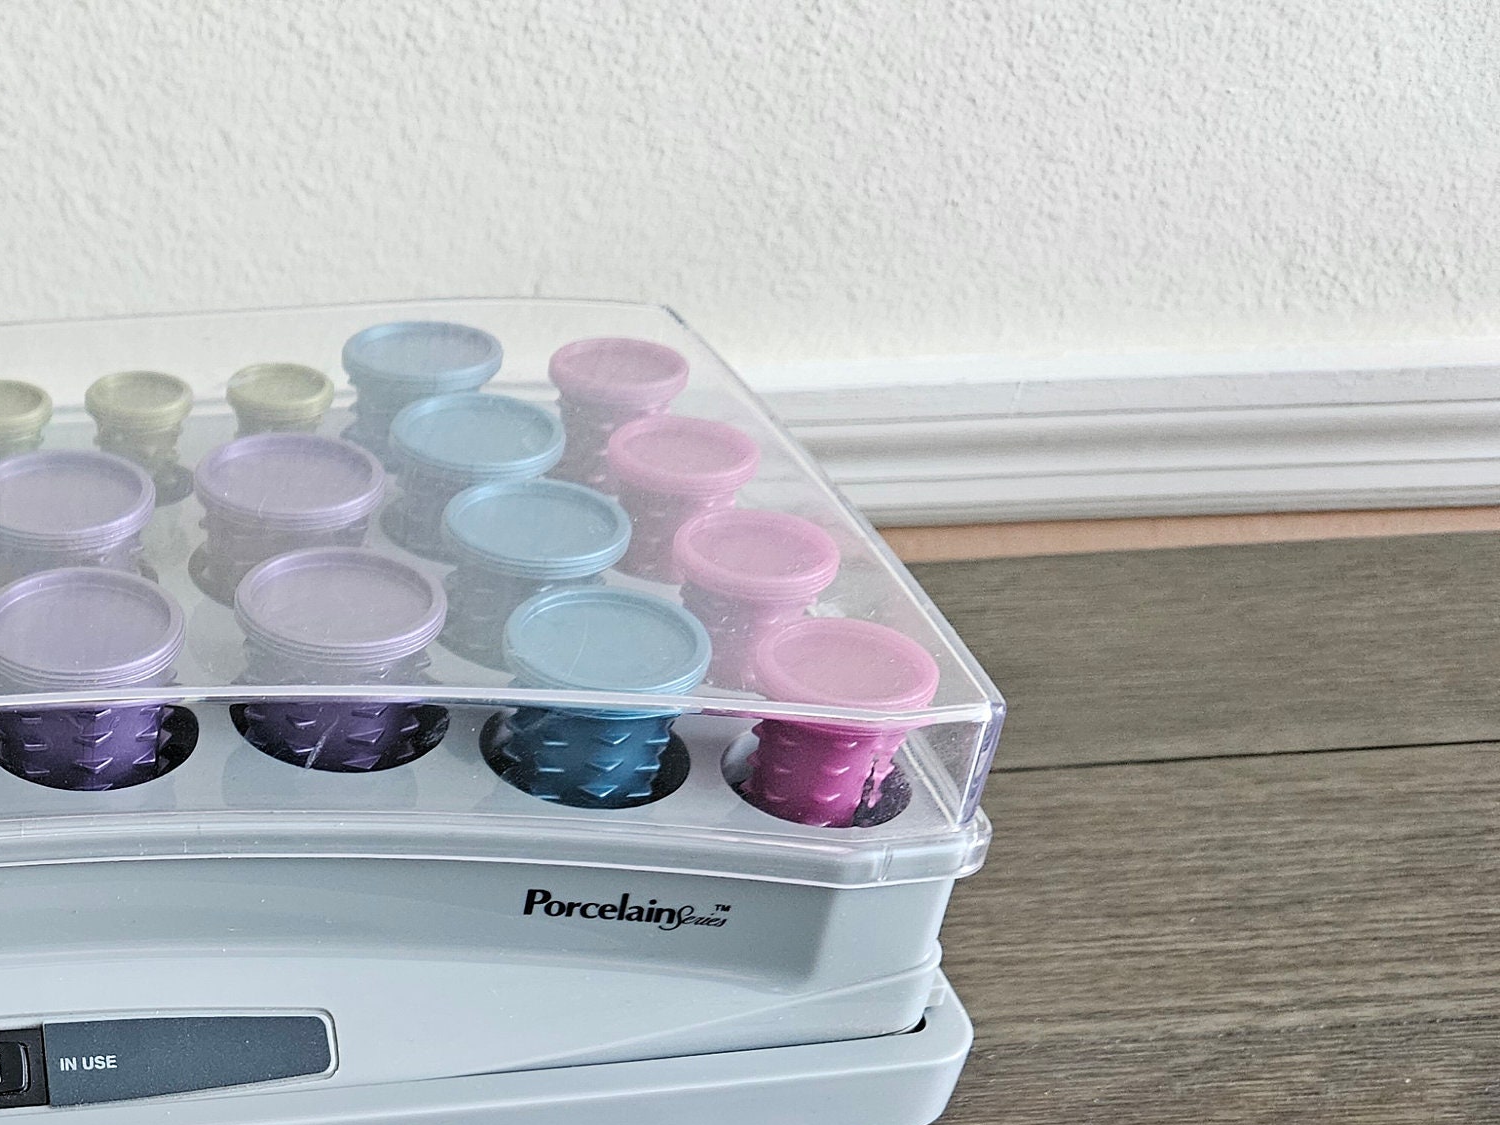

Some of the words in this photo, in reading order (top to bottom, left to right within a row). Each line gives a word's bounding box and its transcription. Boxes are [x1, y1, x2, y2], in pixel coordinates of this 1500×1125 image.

[523, 888, 676, 924] Porcelain
[60, 1056, 78, 1072] IN
[82, 1054, 117, 1071] USE
